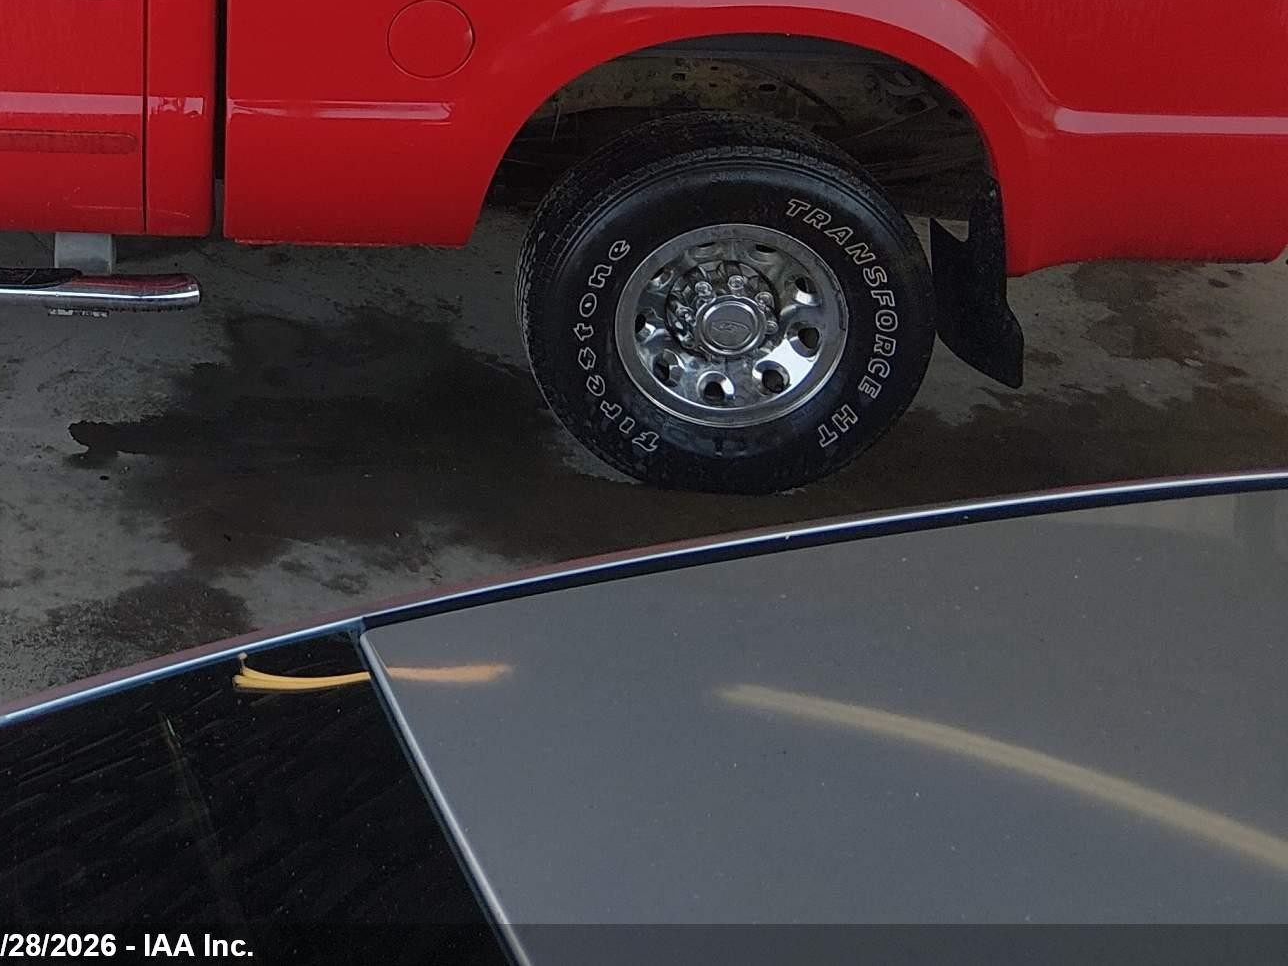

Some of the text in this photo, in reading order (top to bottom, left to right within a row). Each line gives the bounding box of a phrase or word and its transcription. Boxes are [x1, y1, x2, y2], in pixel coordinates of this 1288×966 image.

[573, 239, 660, 453] Firestone
[786, 198, 899, 448] TRANSFORCE HT
